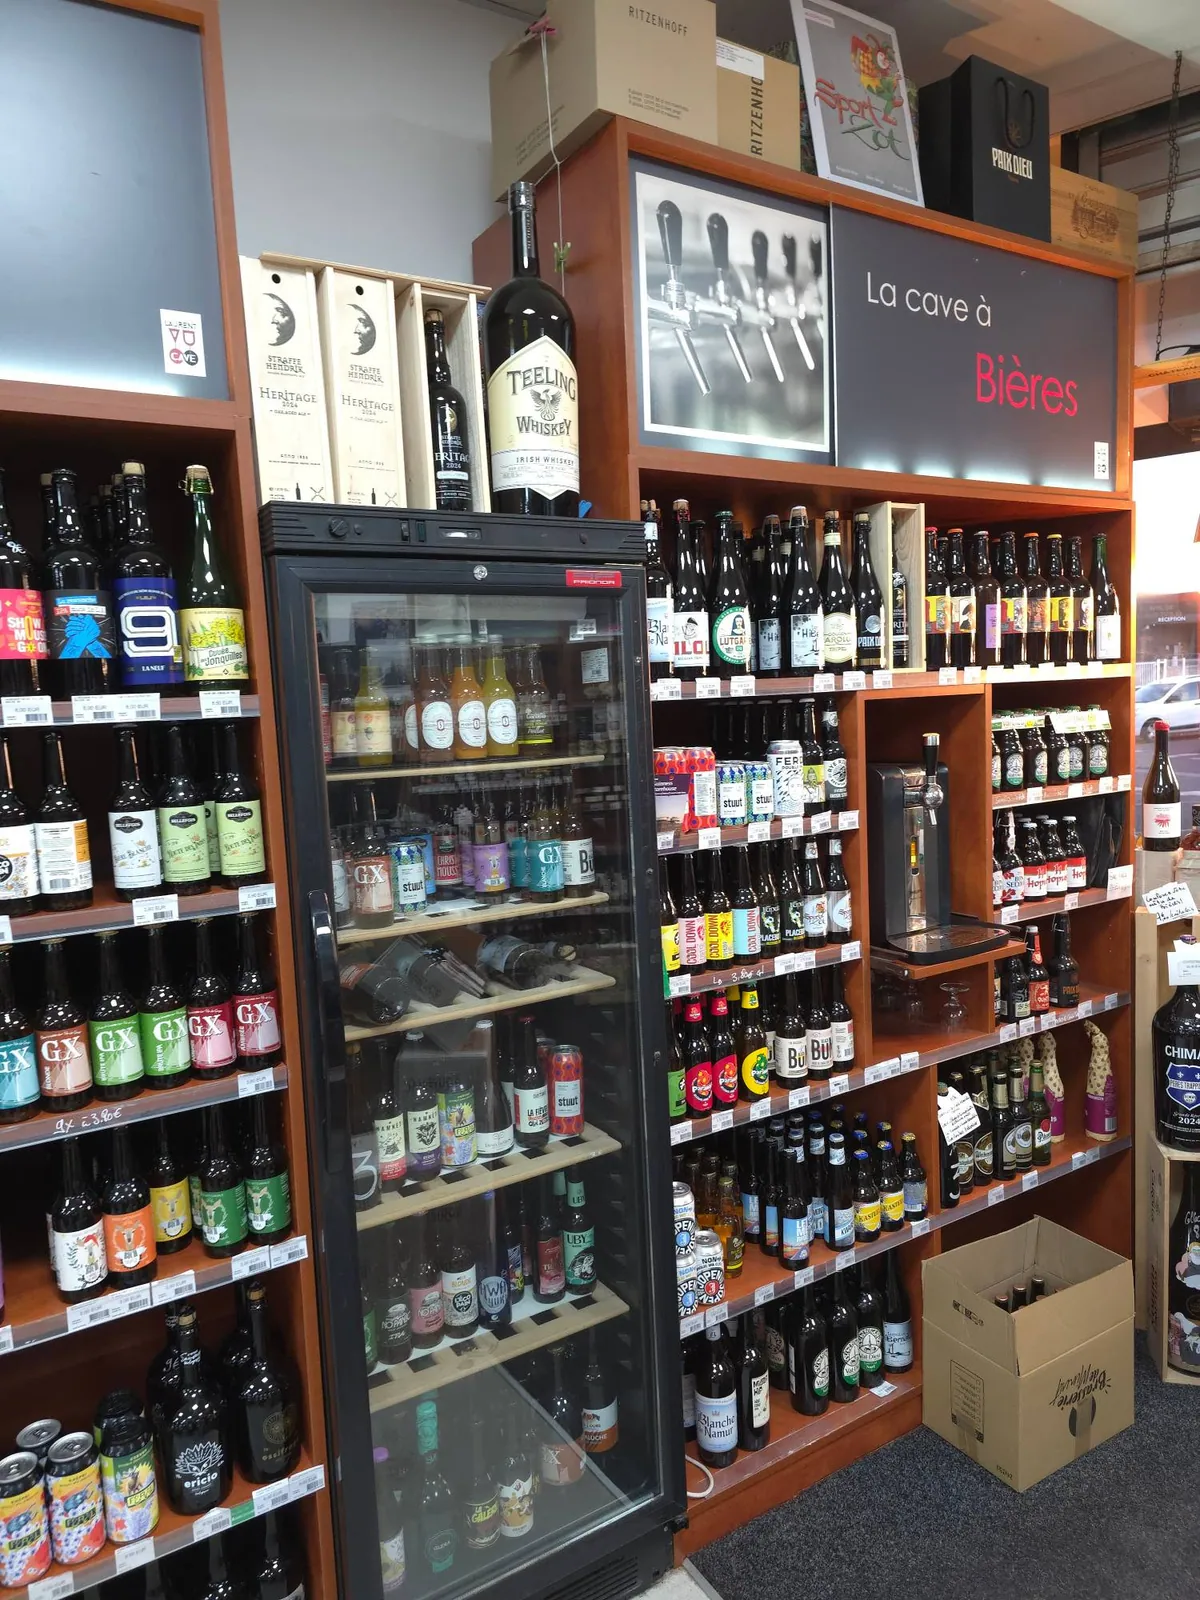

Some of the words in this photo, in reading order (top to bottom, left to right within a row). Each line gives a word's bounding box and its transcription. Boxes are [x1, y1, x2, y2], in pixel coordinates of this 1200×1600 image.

[629, 5, 688, 37] RITZENHOFF
[814, 78, 885, 128] Sport
[842, 115, 910, 160] Zot
[991, 147, 1012, 173] PAIX
[1013, 154, 1033, 180] DIEU
[867, 272, 896, 307] La
[905, 288, 968, 322] cave
[976, 295, 991, 327] à
[266, 363, 305, 374] HENDRIK
[268, 355, 302, 366] STRAFFE
[350, 364, 380, 375] STRAFFE
[348, 371, 384, 383] HENDRIK
[506, 366, 576, 402] TEELING
[977, 352, 1078, 417] Bières
[516, 415, 572, 436] WHISKEY
[516, 456, 540, 464] IRISH
[543, 455, 575, 466] WHISKEY
[120, 606, 177, 657] 9
[858, 637, 874, 647] PAIX
[204, 651, 243, 667] Jonquilles
[723, 798, 743, 808] stuut
[354, 865, 385, 884] GX
[402, 880, 424, 893] stuut
[686, 920, 696, 943] DOWN
[709, 914, 719, 937] DOWN
[747, 909, 756, 932] DOWN
[686, 943, 696, 965] COOL
[709, 938, 719, 959] COOL
[236, 1001, 272, 1024] GX
[153, 1017, 188, 1041] GX
[188, 1014, 224, 1036] GX
[41, 1036, 84, 1061] GX
[95, 1027, 137, 1052] GX
[558, 1096, 579, 1108] stuut
[567, 1234, 587, 1245] UBY
[703, 1425, 734, 1440] Namur
[184, 1471, 218, 1488] ericio
